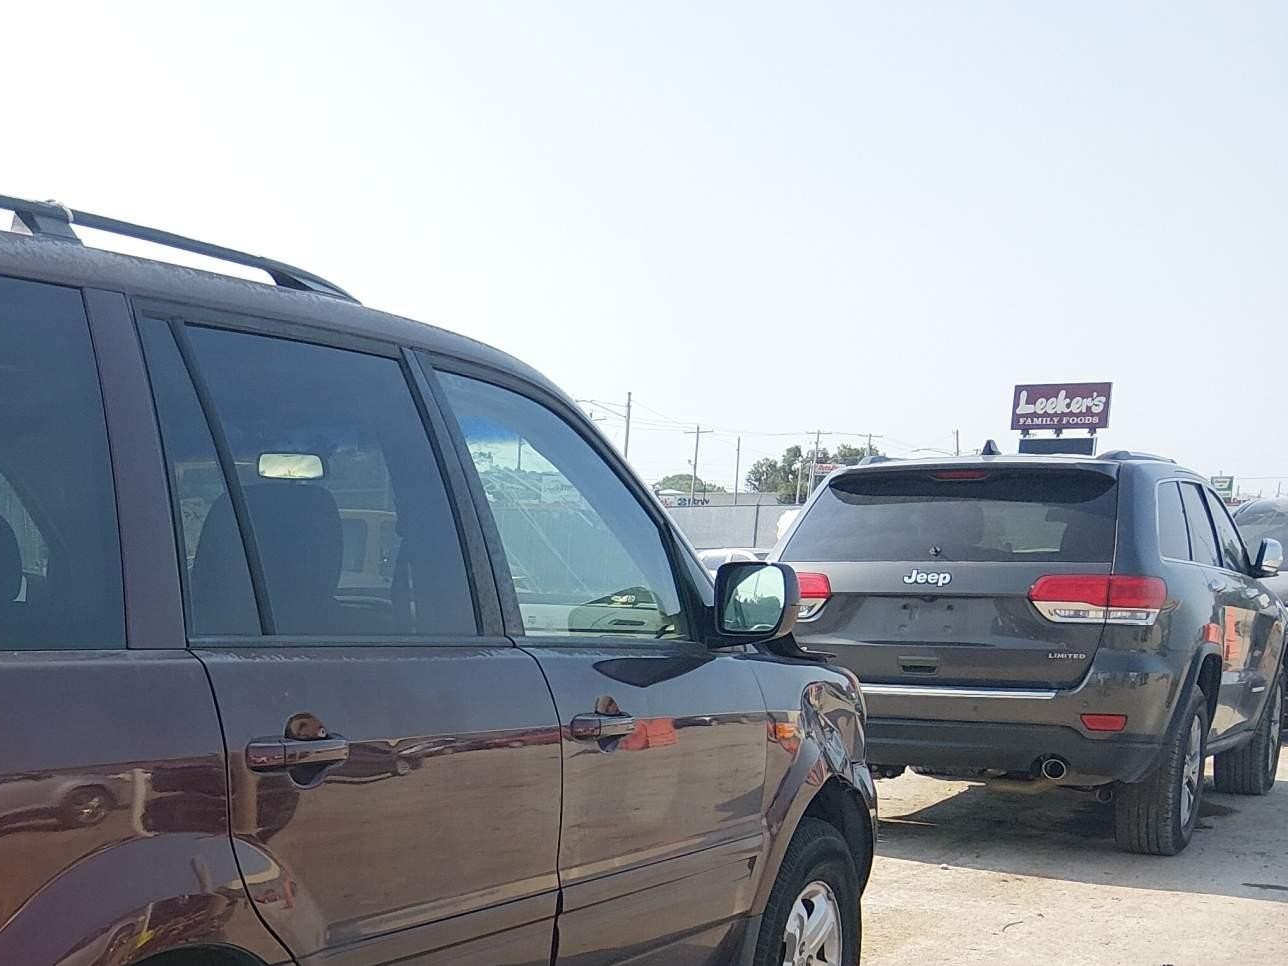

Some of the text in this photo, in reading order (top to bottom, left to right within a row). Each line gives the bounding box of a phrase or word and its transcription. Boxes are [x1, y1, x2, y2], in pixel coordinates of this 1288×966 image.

[1016, 390, 1106, 414] Leeker's
[1018, 416, 1099, 425] FAMILY FOODS
[903, 569, 952, 587] Jeep
